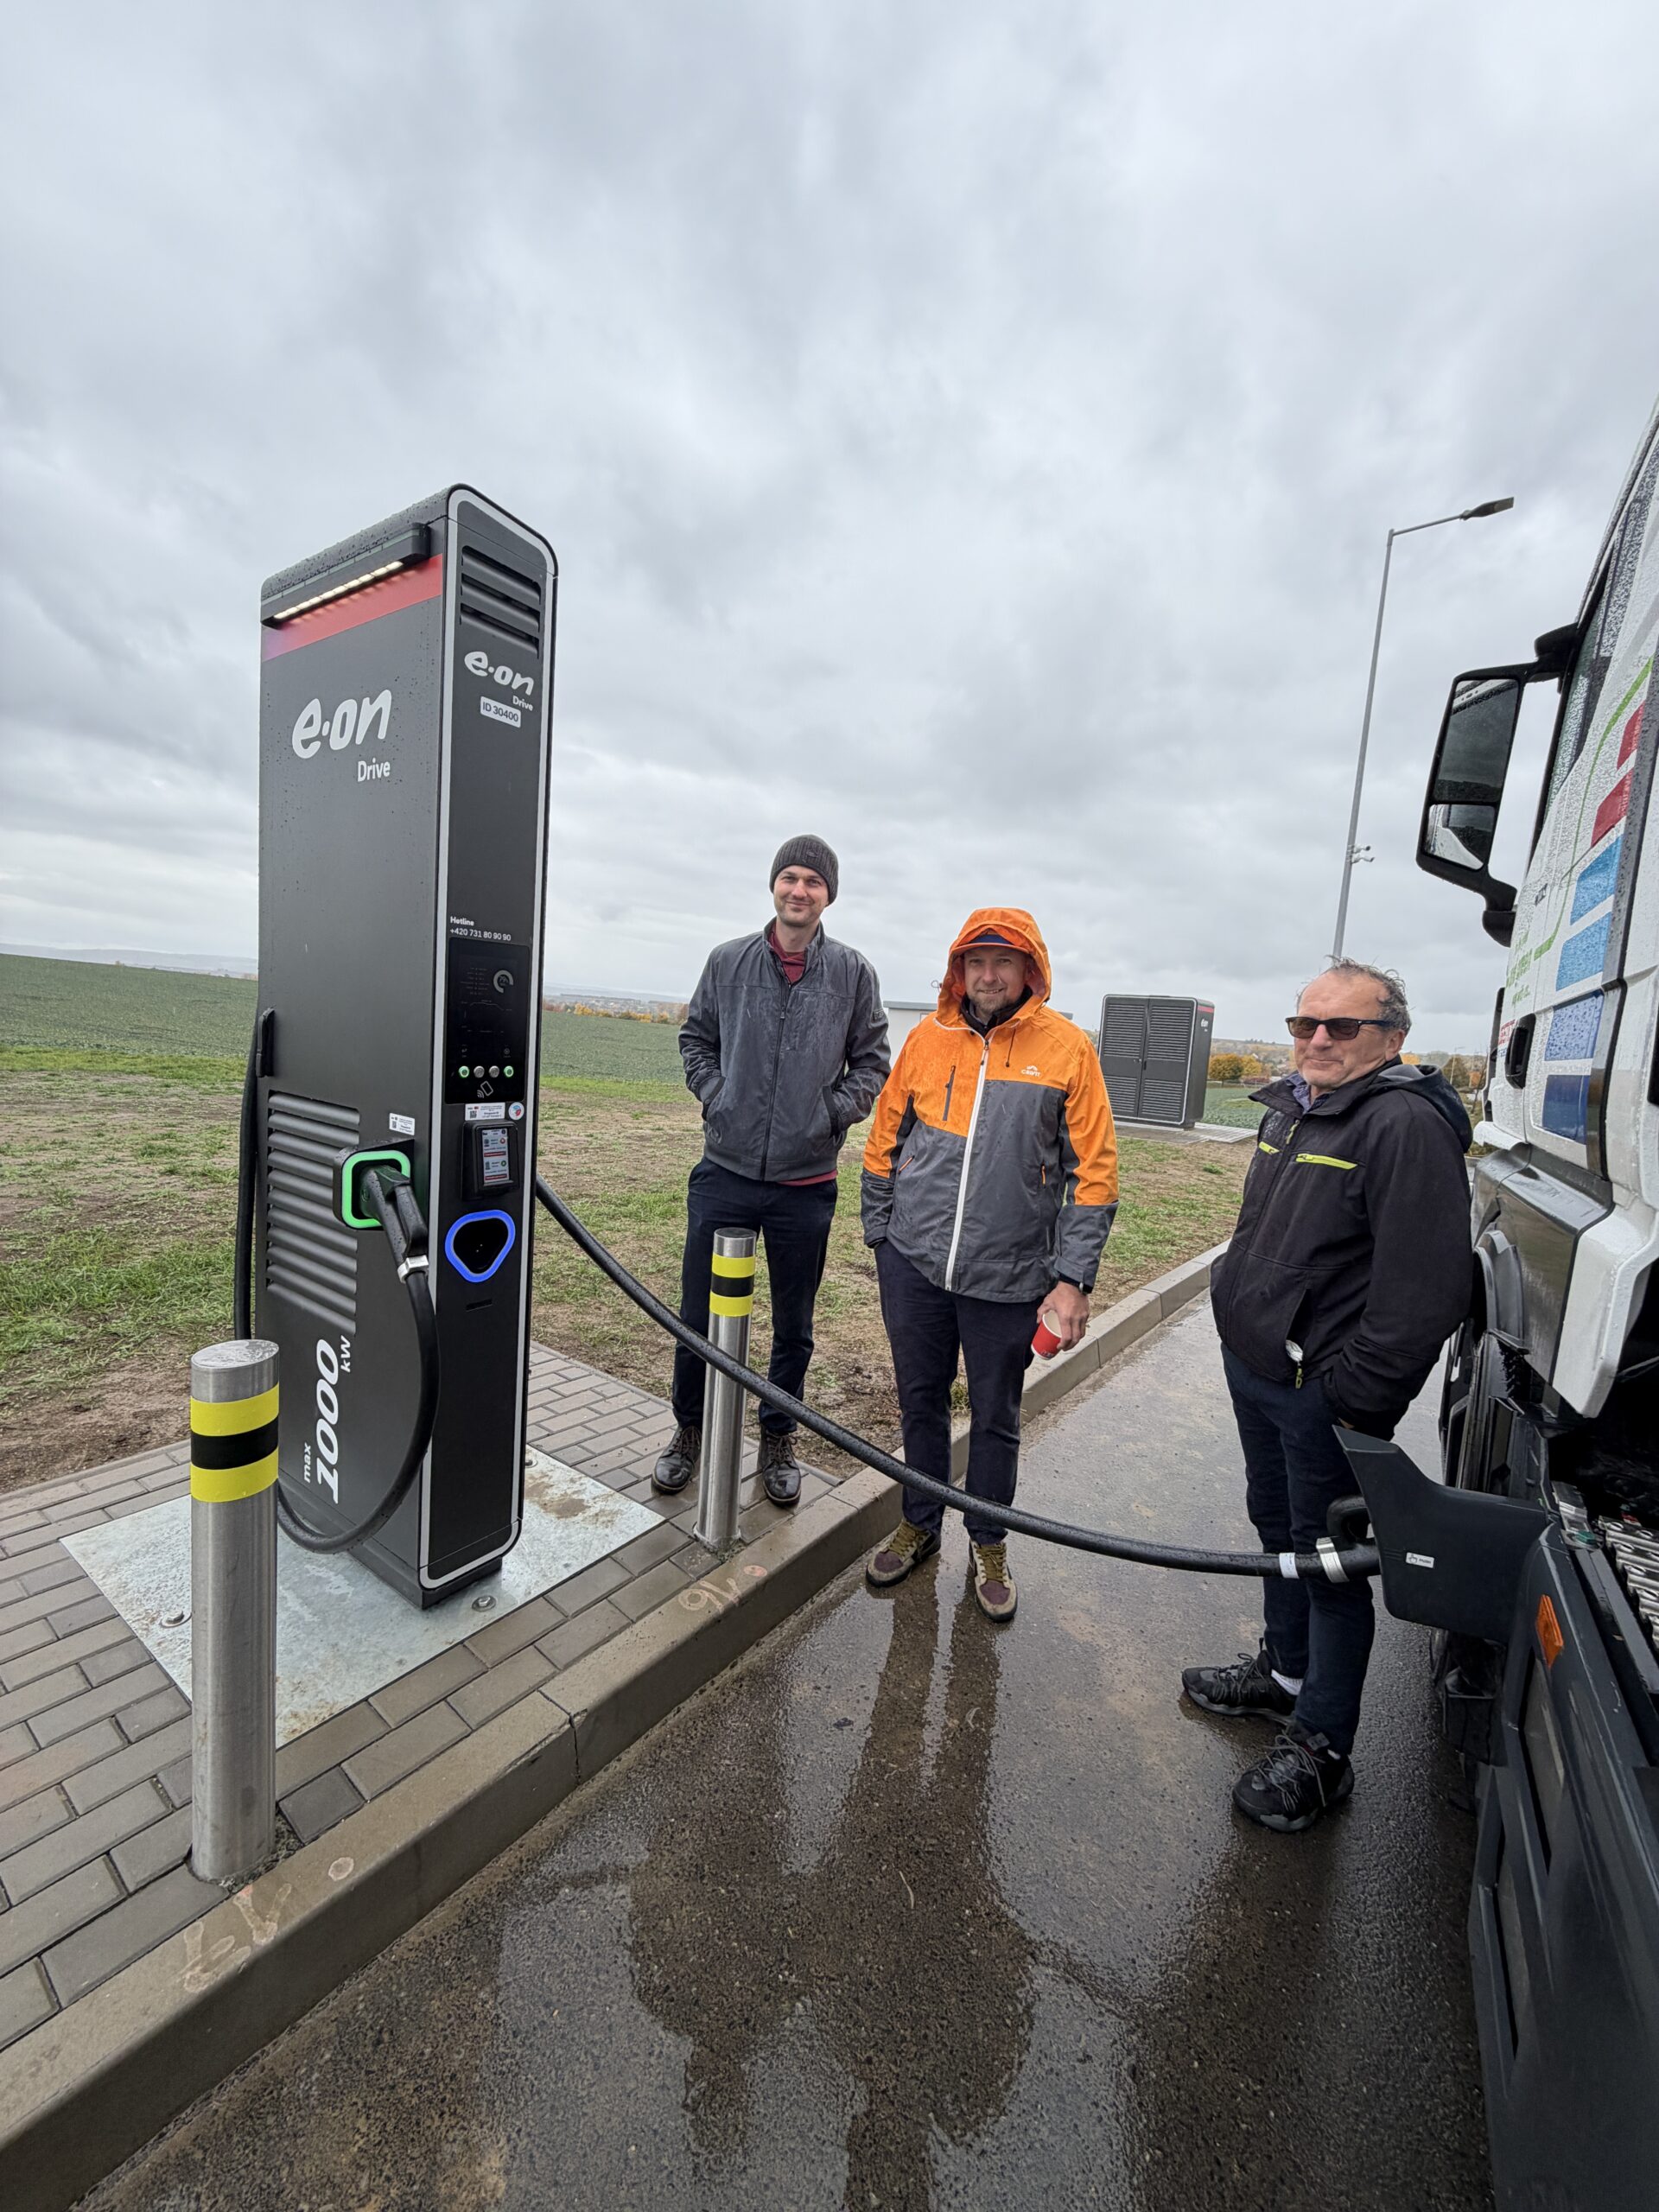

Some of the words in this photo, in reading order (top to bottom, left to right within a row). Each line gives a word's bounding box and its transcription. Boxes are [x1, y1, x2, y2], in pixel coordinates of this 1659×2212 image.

[483, 702, 492, 712] ID
[493, 705, 519, 722] 30400
[512, 695, 534, 711] Drive
[357, 757, 391, 782] Drive
[450, 916, 474, 926] Hotline
[450, 927, 468, 936] +420
[469, 929, 482, 938] 731
[483, 931, 492, 939] 80
[316, 1338, 339, 1504] 1000
